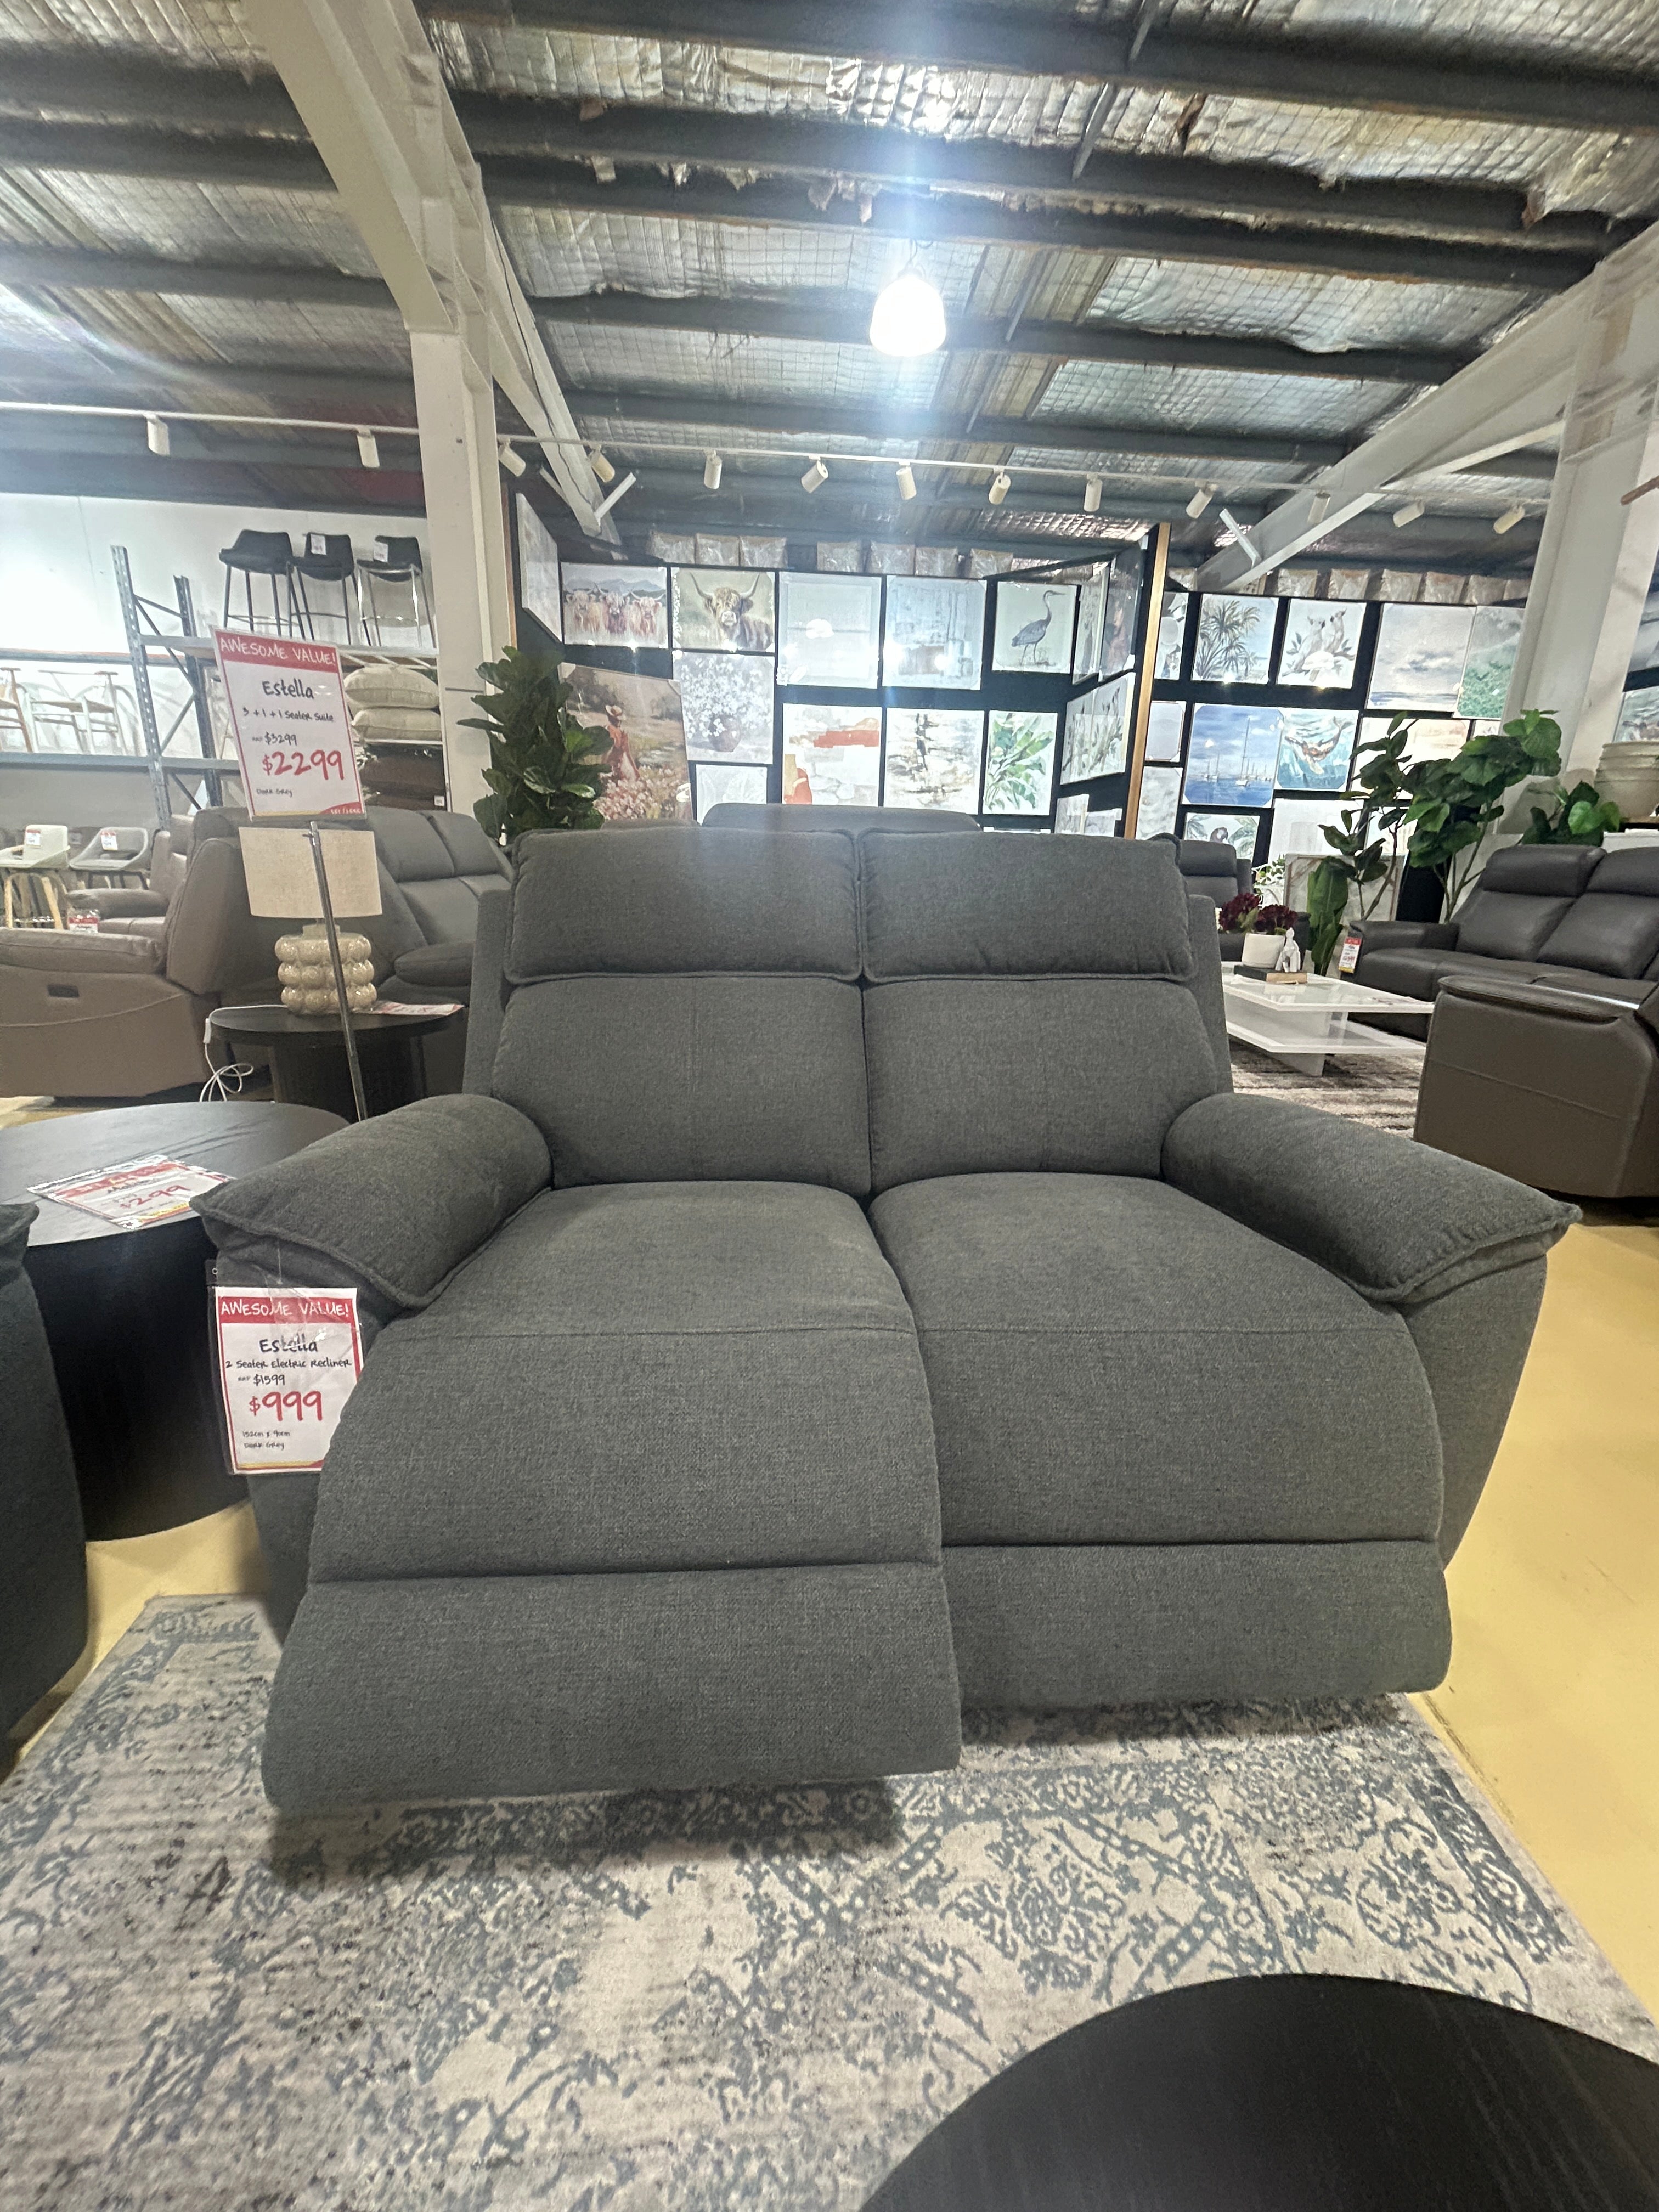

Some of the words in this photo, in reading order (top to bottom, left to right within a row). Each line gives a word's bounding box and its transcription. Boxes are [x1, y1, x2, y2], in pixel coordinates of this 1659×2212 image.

[221, 637, 288, 659] AWESOME
[292, 648, 336, 666] VALUE!
[262, 678, 314, 699] Estella
[264, 731, 297, 746] $3299
[262, 749, 345, 781] $2299
[221, 1299, 292, 1316] AWESOME
[298, 1301, 349, 1317] VALUE!
[259, 1333, 318, 1352] Estella
[253, 1374, 285, 1386] $1599
[249, 1391, 323, 1421] $999
